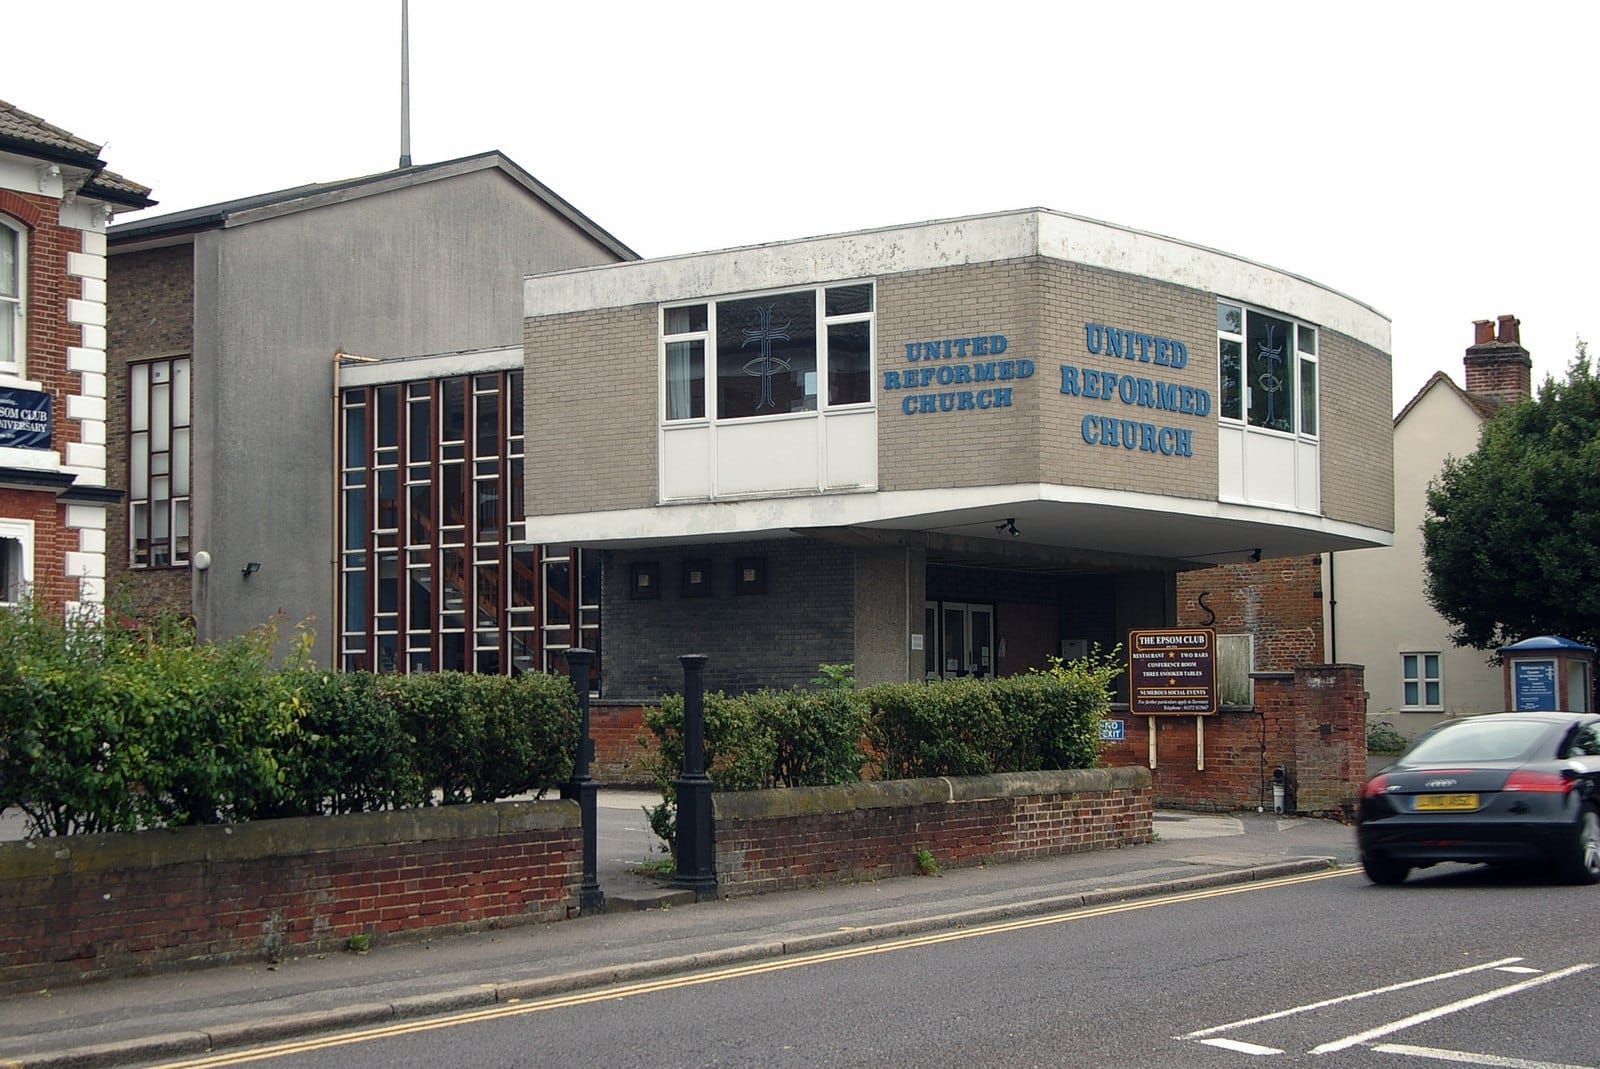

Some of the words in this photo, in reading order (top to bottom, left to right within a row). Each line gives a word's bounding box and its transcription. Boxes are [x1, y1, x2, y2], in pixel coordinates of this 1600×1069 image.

[905, 334, 1008, 362] UNITED
[1085, 322, 1189, 370] UNITED
[883, 358, 1035, 390] REFORMED
[902, 387, 1013, 415] CHURCH
[1060, 364, 1212, 417] REFORMED
[20, 409, 47, 422] CLUB
[1081, 414, 1193, 457] CHURCH
[1139, 636, 1155, 645] THE
[1156, 636, 1182, 645] EPSOM
[1183, 635, 1204, 644] CLUB
